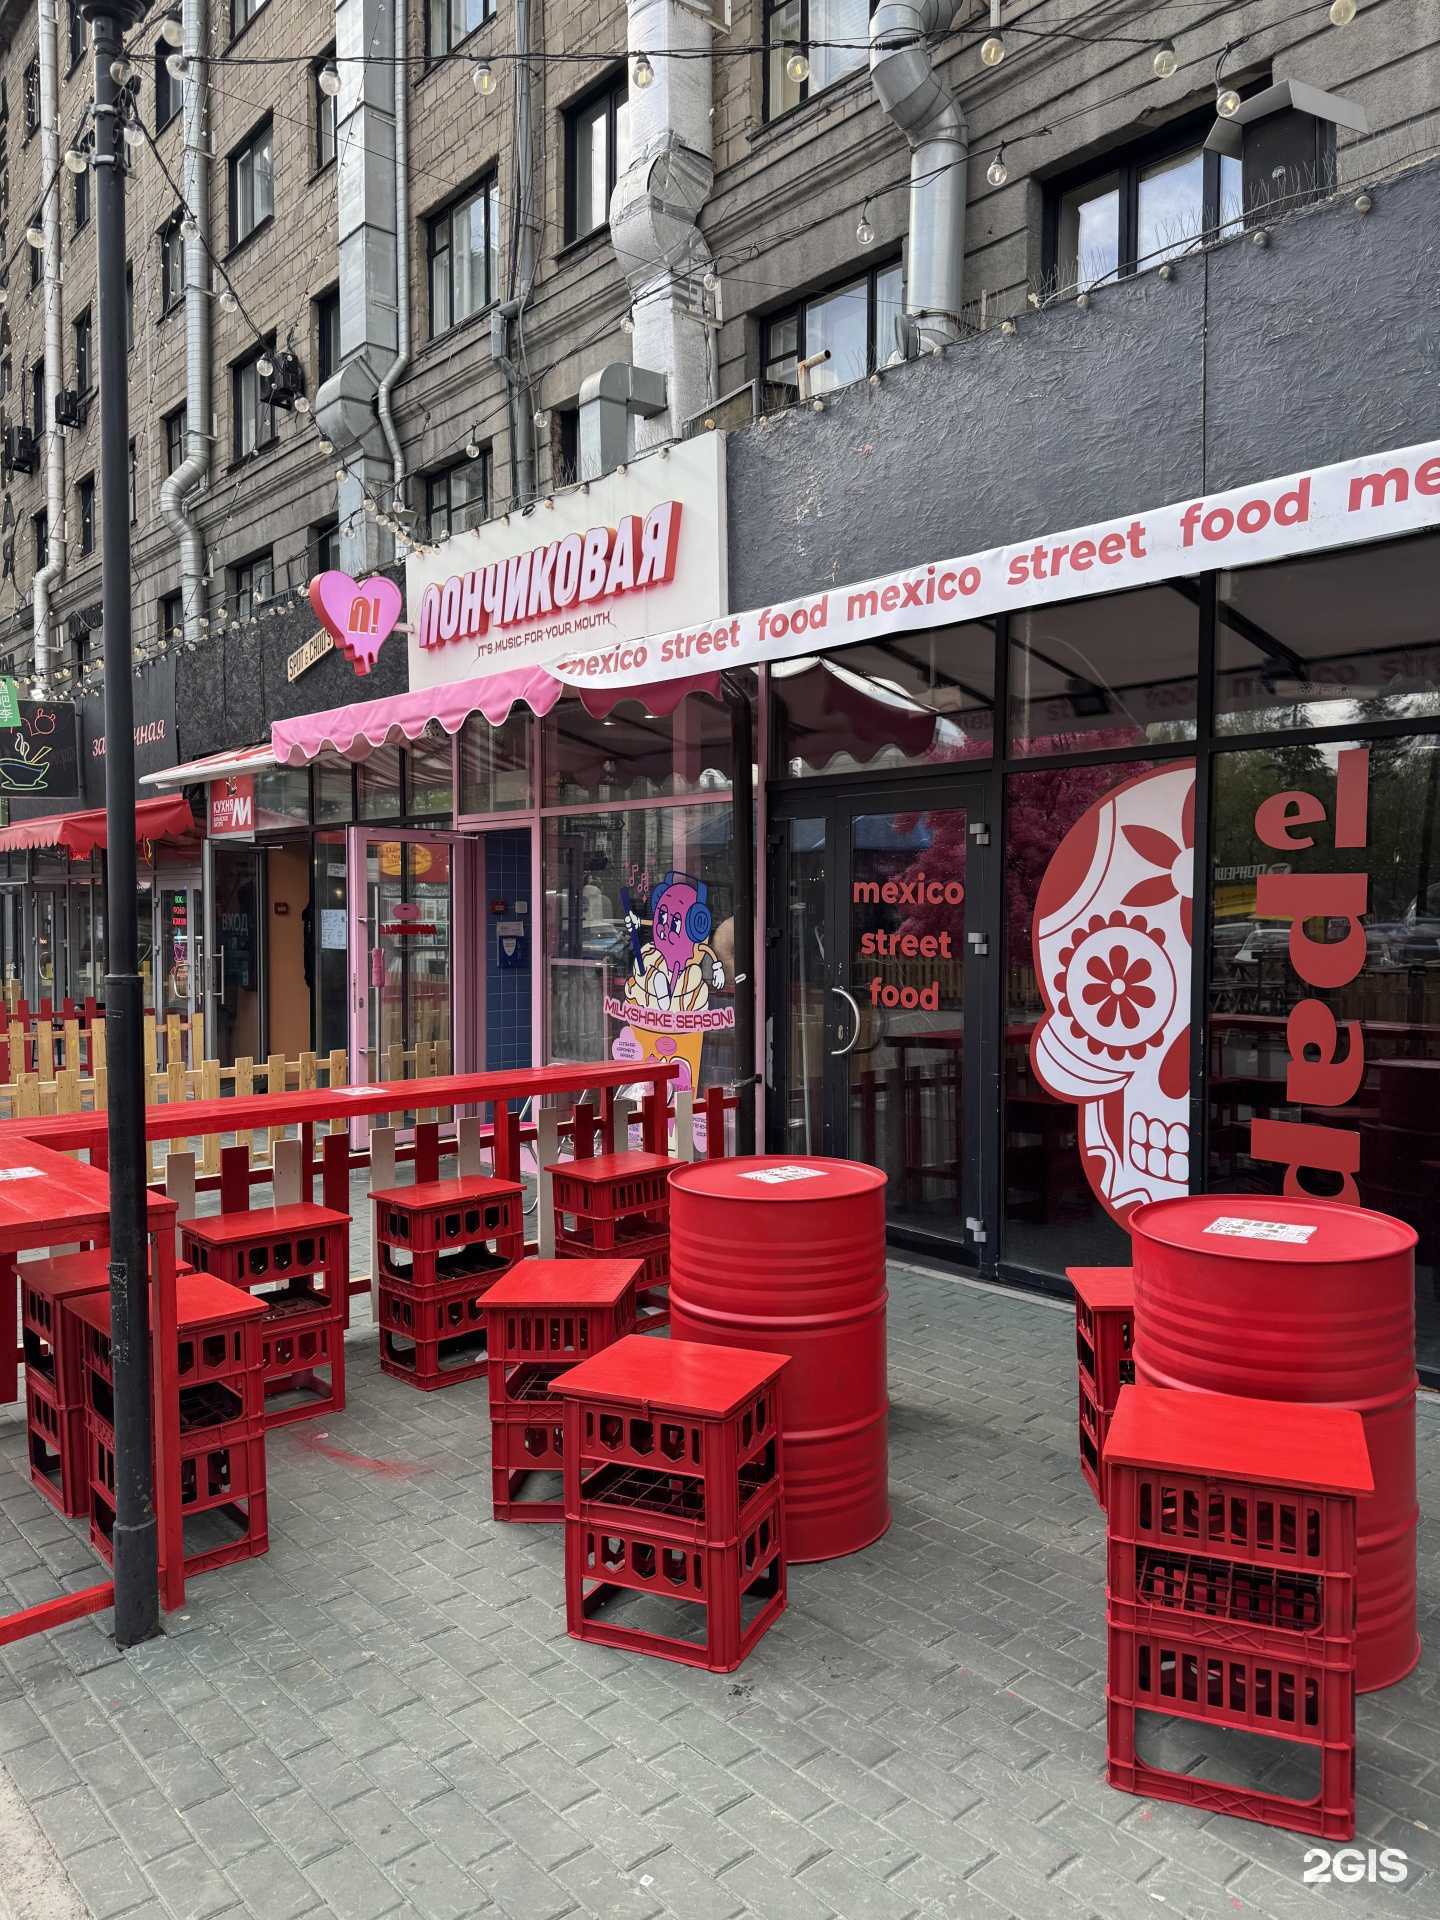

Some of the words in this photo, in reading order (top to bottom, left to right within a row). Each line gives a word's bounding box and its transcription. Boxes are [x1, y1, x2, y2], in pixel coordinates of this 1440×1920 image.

[420, 501, 683, 650] ПОНЧИКОВАЯ
[556, 641, 647, 676] mexico
[661, 619, 741, 661] street
[757, 598, 829, 641] food
[847, 565, 982, 621] mexico
[1007, 522, 1147, 587] street
[1179, 476, 1311, 548] food
[478, 642, 494, 657] IT'S
[494, 635, 523, 654] MUSIC
[525, 629, 544, 646] FOR
[545, 621, 572, 640] YOUR
[574, 611, 611, 631] MOUTH
[213, 798, 233, 814] КУХНЯ
[1255, 750, 1368, 849] el
[853, 871, 964, 905] mexico
[222, 912, 249, 937] ВХОД
[860, 929, 951, 958] street
[870, 977, 939, 1011] food
[604, 998, 673, 1027] MILKSHAKE
[676, 1008, 735, 1029] SEASON!
